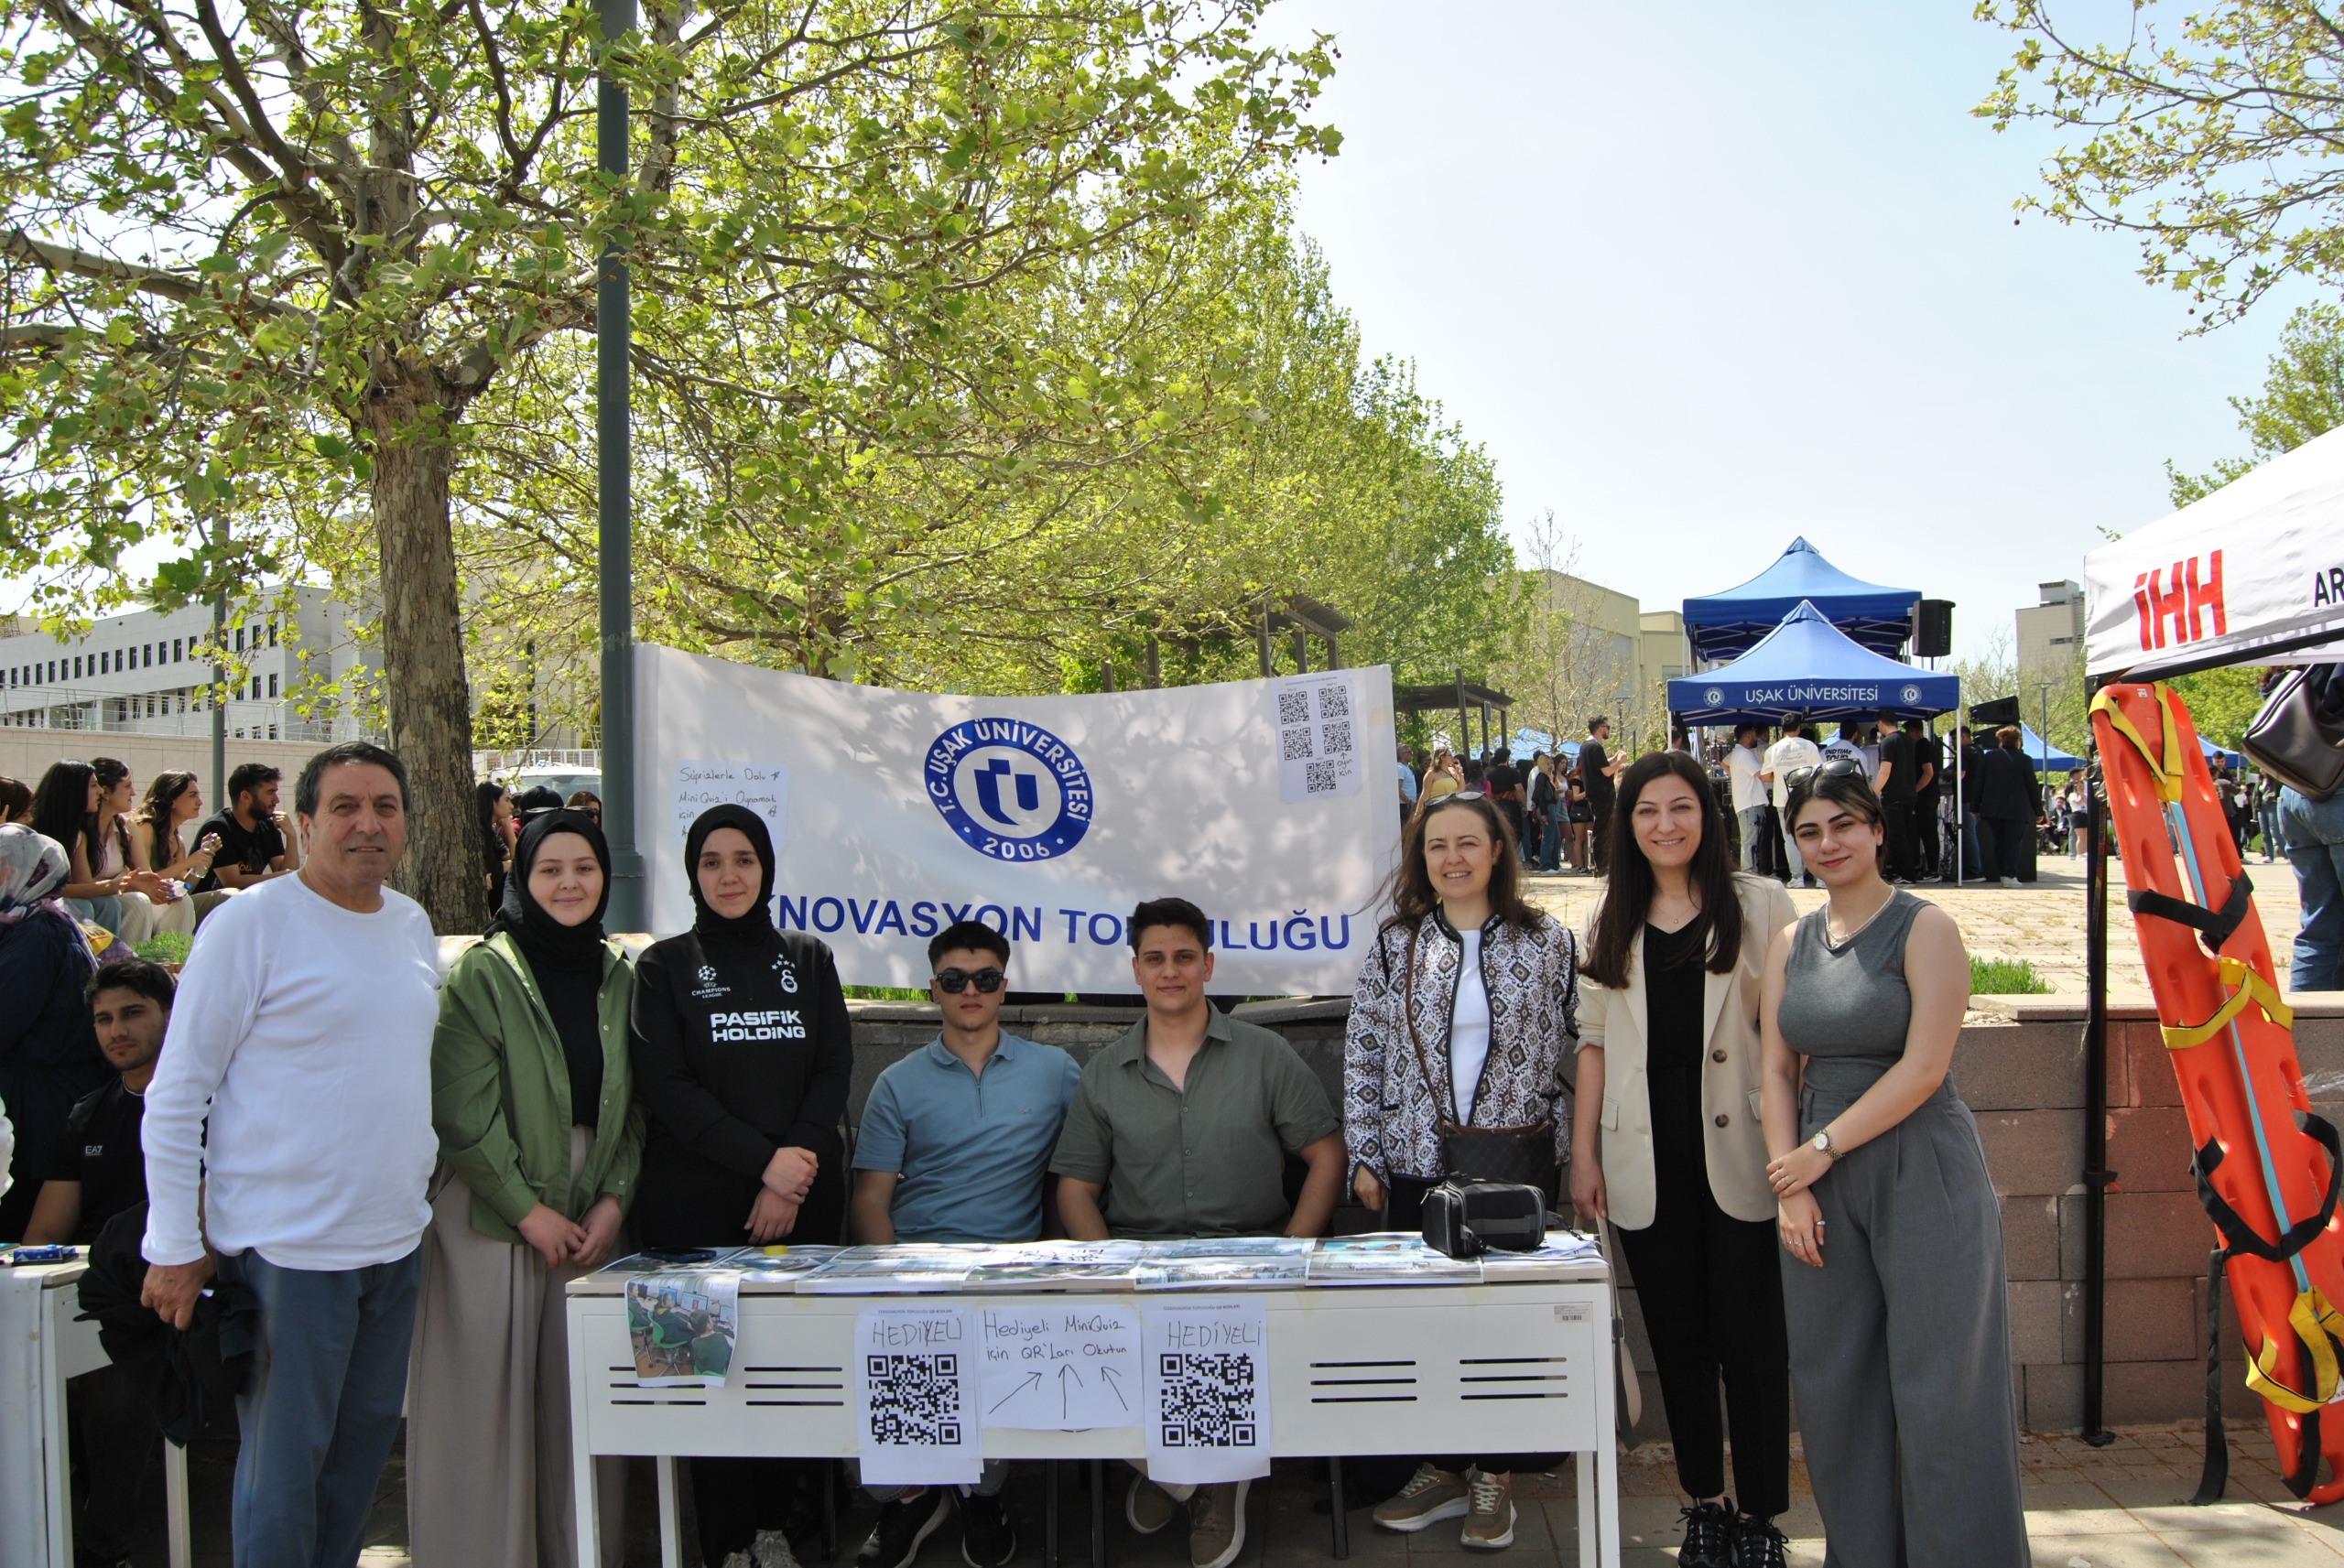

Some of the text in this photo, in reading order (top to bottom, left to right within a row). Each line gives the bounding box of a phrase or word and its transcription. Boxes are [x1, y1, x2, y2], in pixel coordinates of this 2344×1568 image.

[2134, 549, 2227, 652] İHH
[1745, 685, 1878, 704] UŞAK ÜNİVERSİTESİ
[743, 768, 766, 781] Dolu
[974, 718, 1091, 823] ÜNİVERSİTESİ
[1337, 759, 1353, 770] Oyun
[982, 837, 1050, 860] 2006
[767, 894, 1350, 952] NOVASYON TOLUĞU
[691, 987, 731, 997] CHAMPIONS
[85, 1145, 103, 1153] EA7
[873, 1318, 962, 1347] HEDİYELİ
[984, 1311, 1049, 1343] Hediyeli
[1167, 1321, 1261, 1349] HEDİYELİ
[986, 1346, 1009, 1361] için
